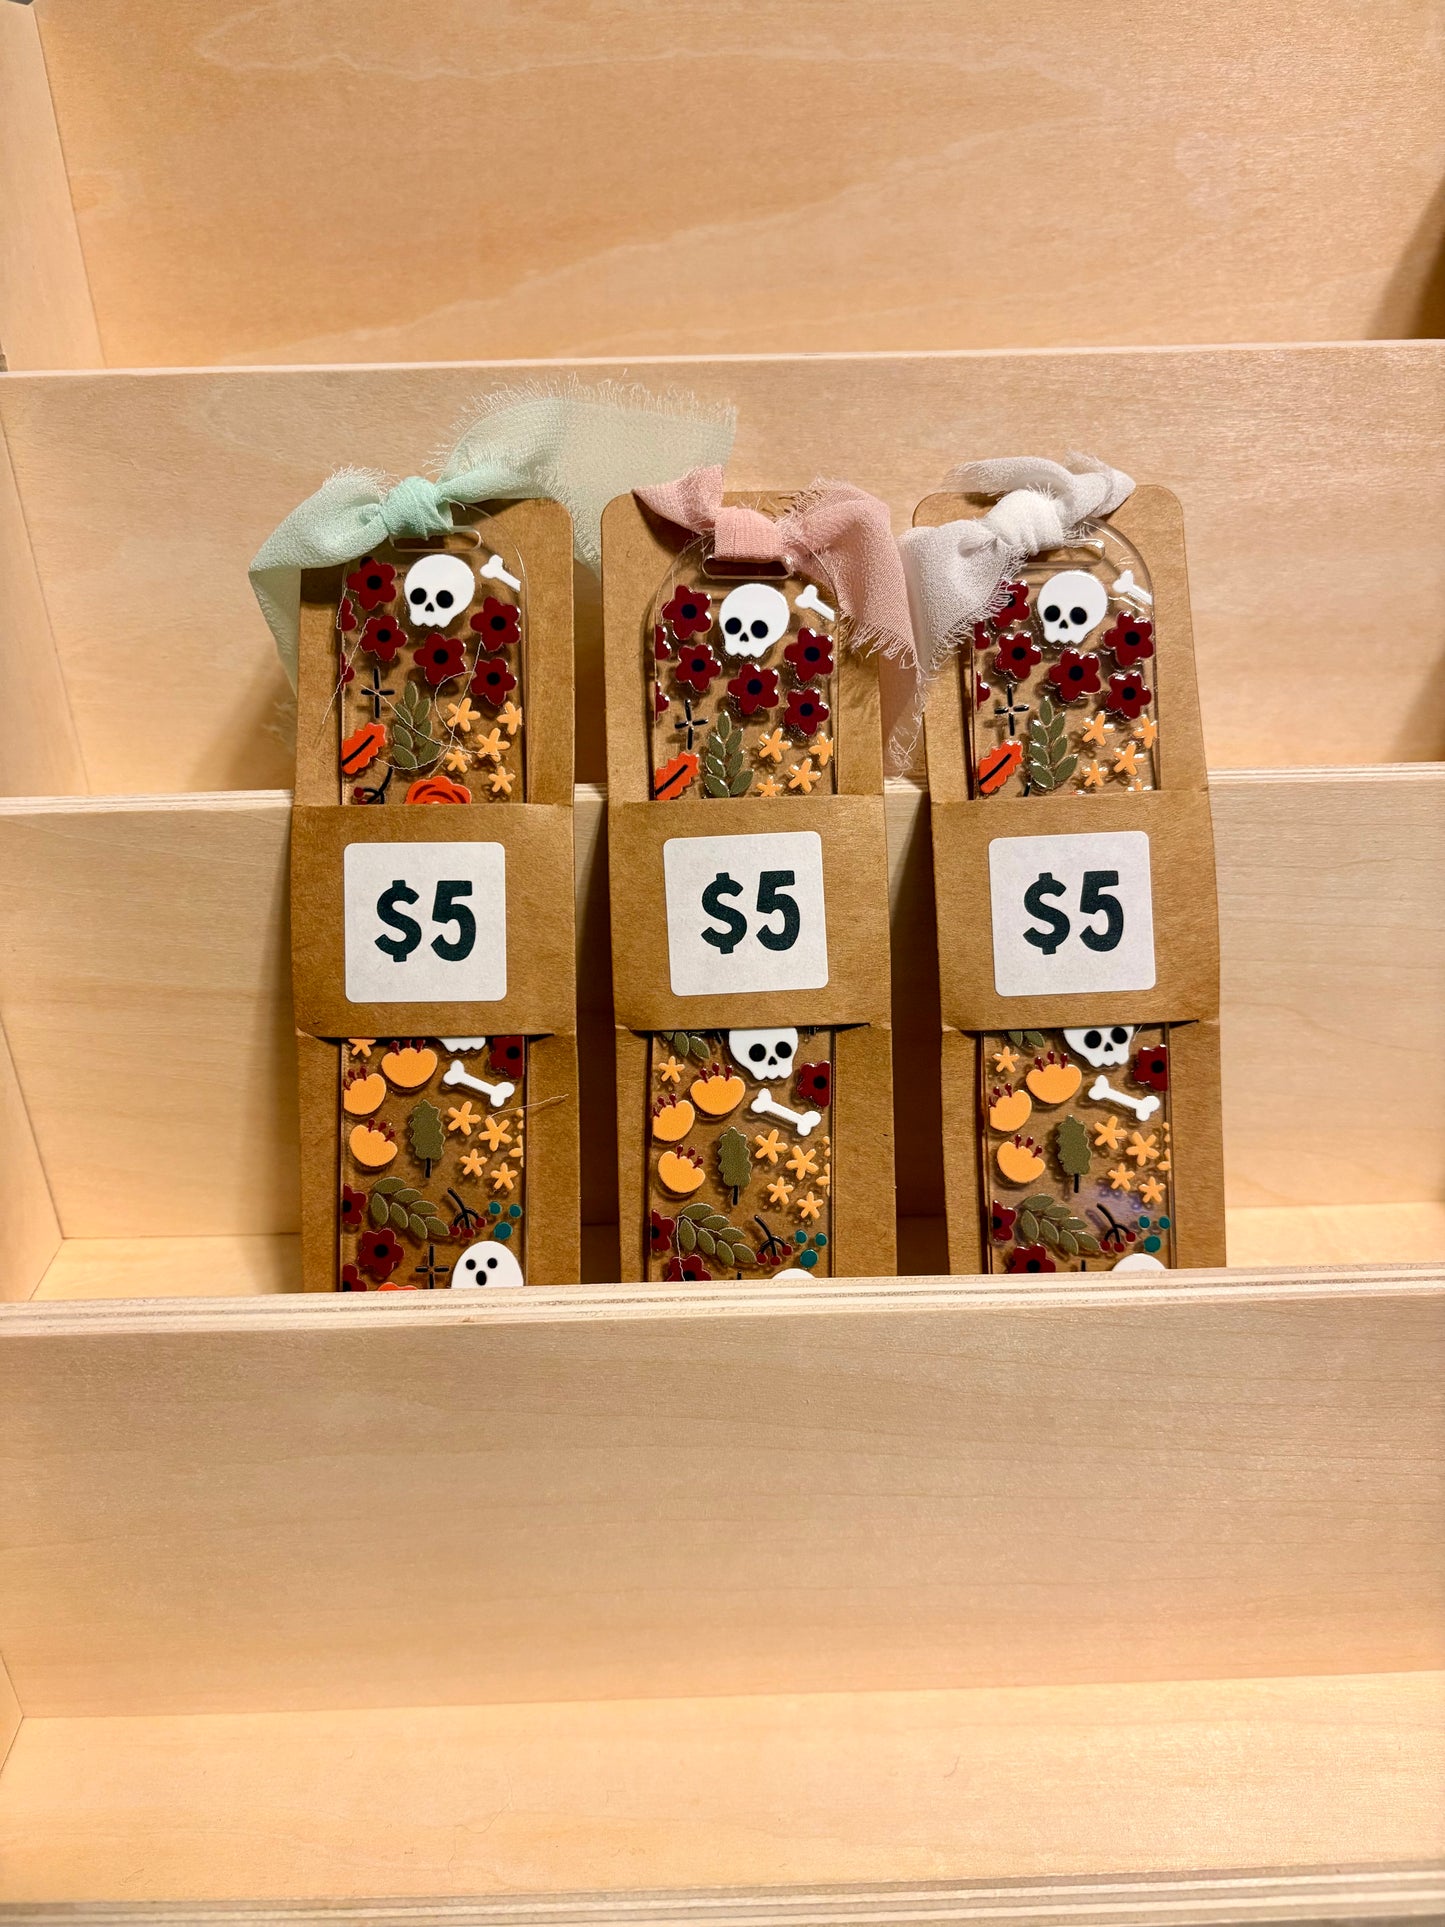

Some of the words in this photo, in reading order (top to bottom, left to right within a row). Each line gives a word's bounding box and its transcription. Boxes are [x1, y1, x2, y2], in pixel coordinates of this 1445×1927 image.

[374, 879, 477, 963] $5
[700, 870, 801, 955] $5
[1022, 870, 1124, 956] $5
